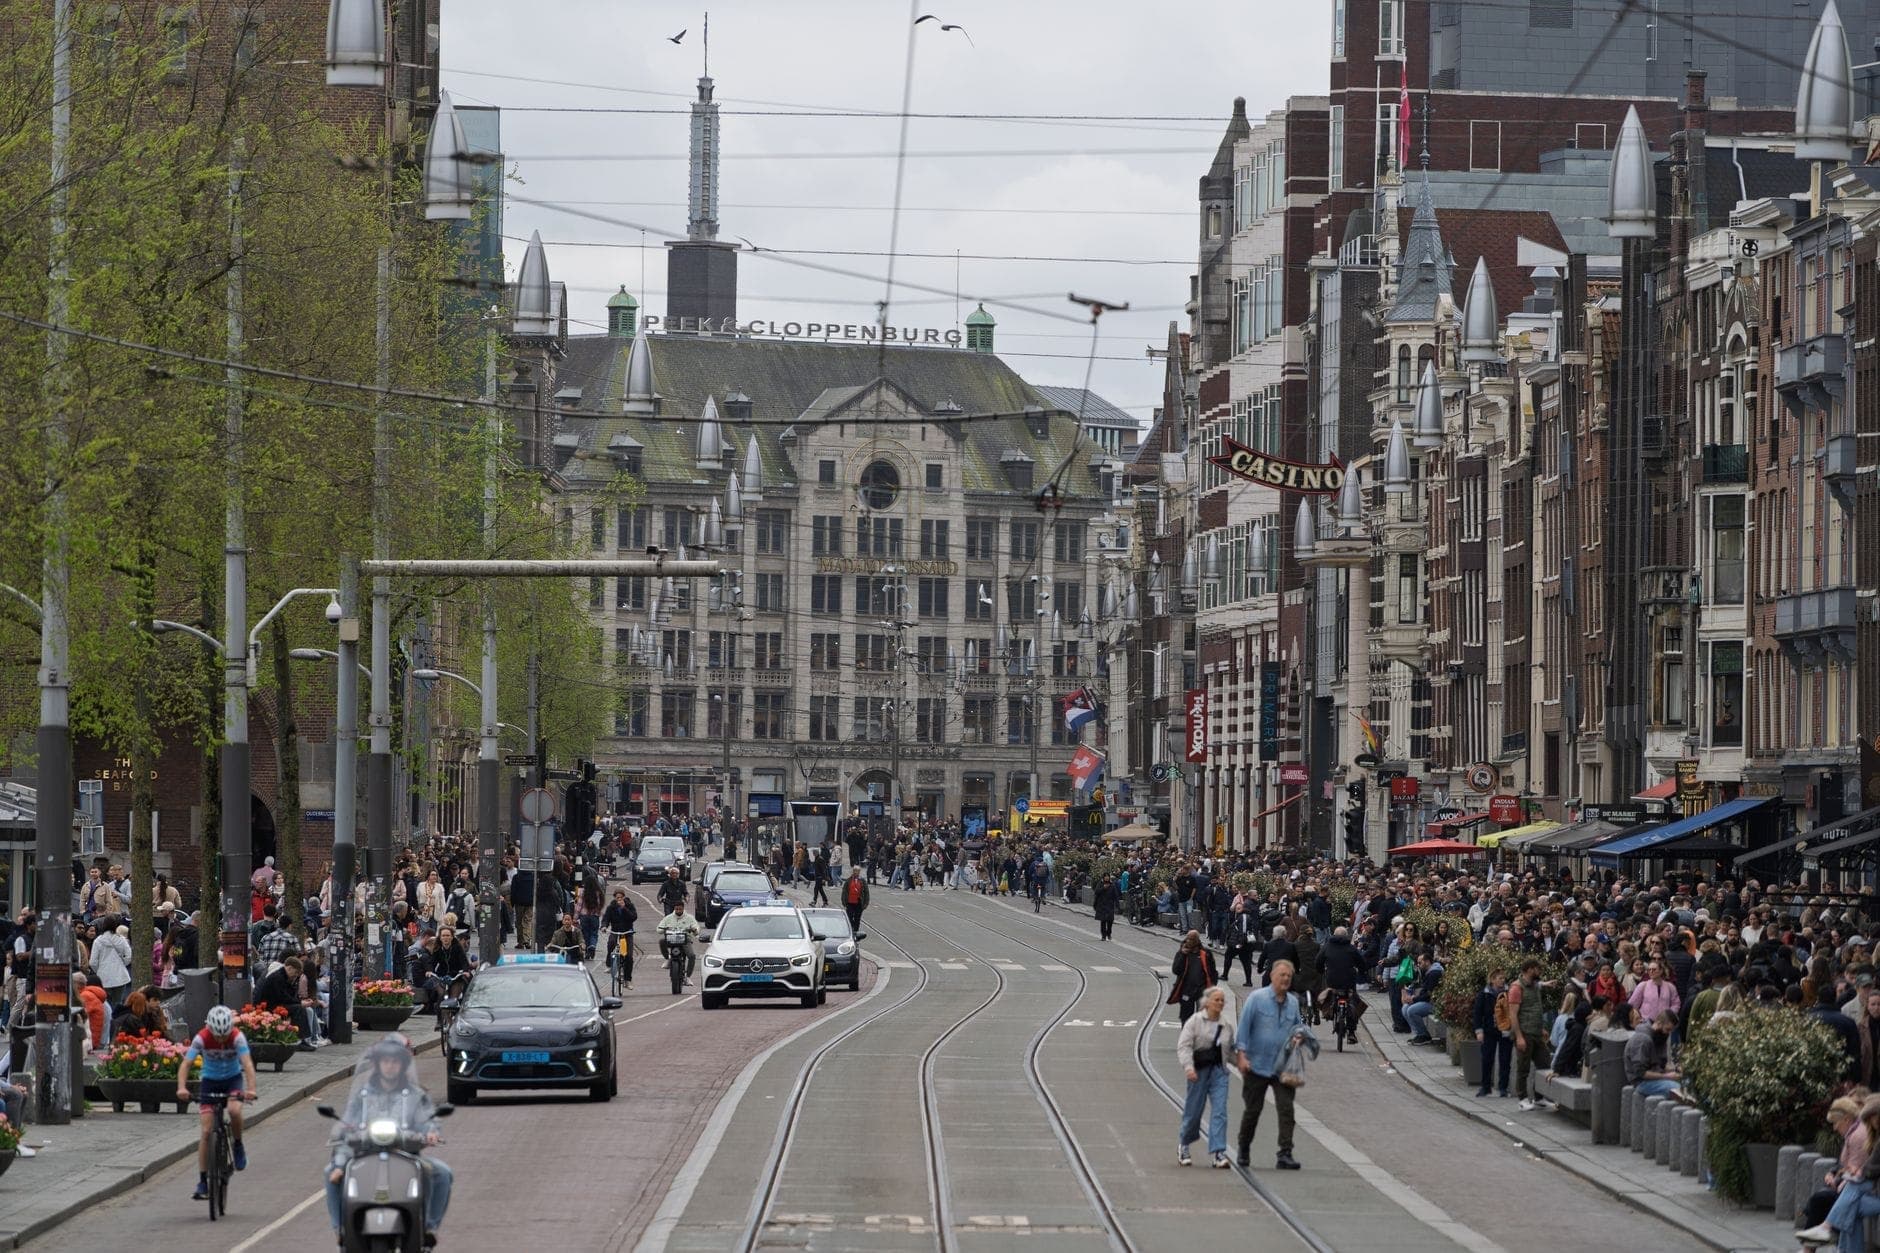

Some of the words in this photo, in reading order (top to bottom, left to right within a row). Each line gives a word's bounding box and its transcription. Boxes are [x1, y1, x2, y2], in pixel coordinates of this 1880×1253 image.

[644, 315, 712, 331] PEEK
[720, 317, 743, 333] &
[750, 320, 962, 344] CLOPPENBURG
[1231, 450, 1345, 490] CASINO
[1263, 672, 1276, 751] PRIMARK
[114, 758, 131, 768] TH
[94, 769, 159, 780] SEAFOD
[113, 781, 134, 792] BA
[1439, 812, 1459, 821] WOK
